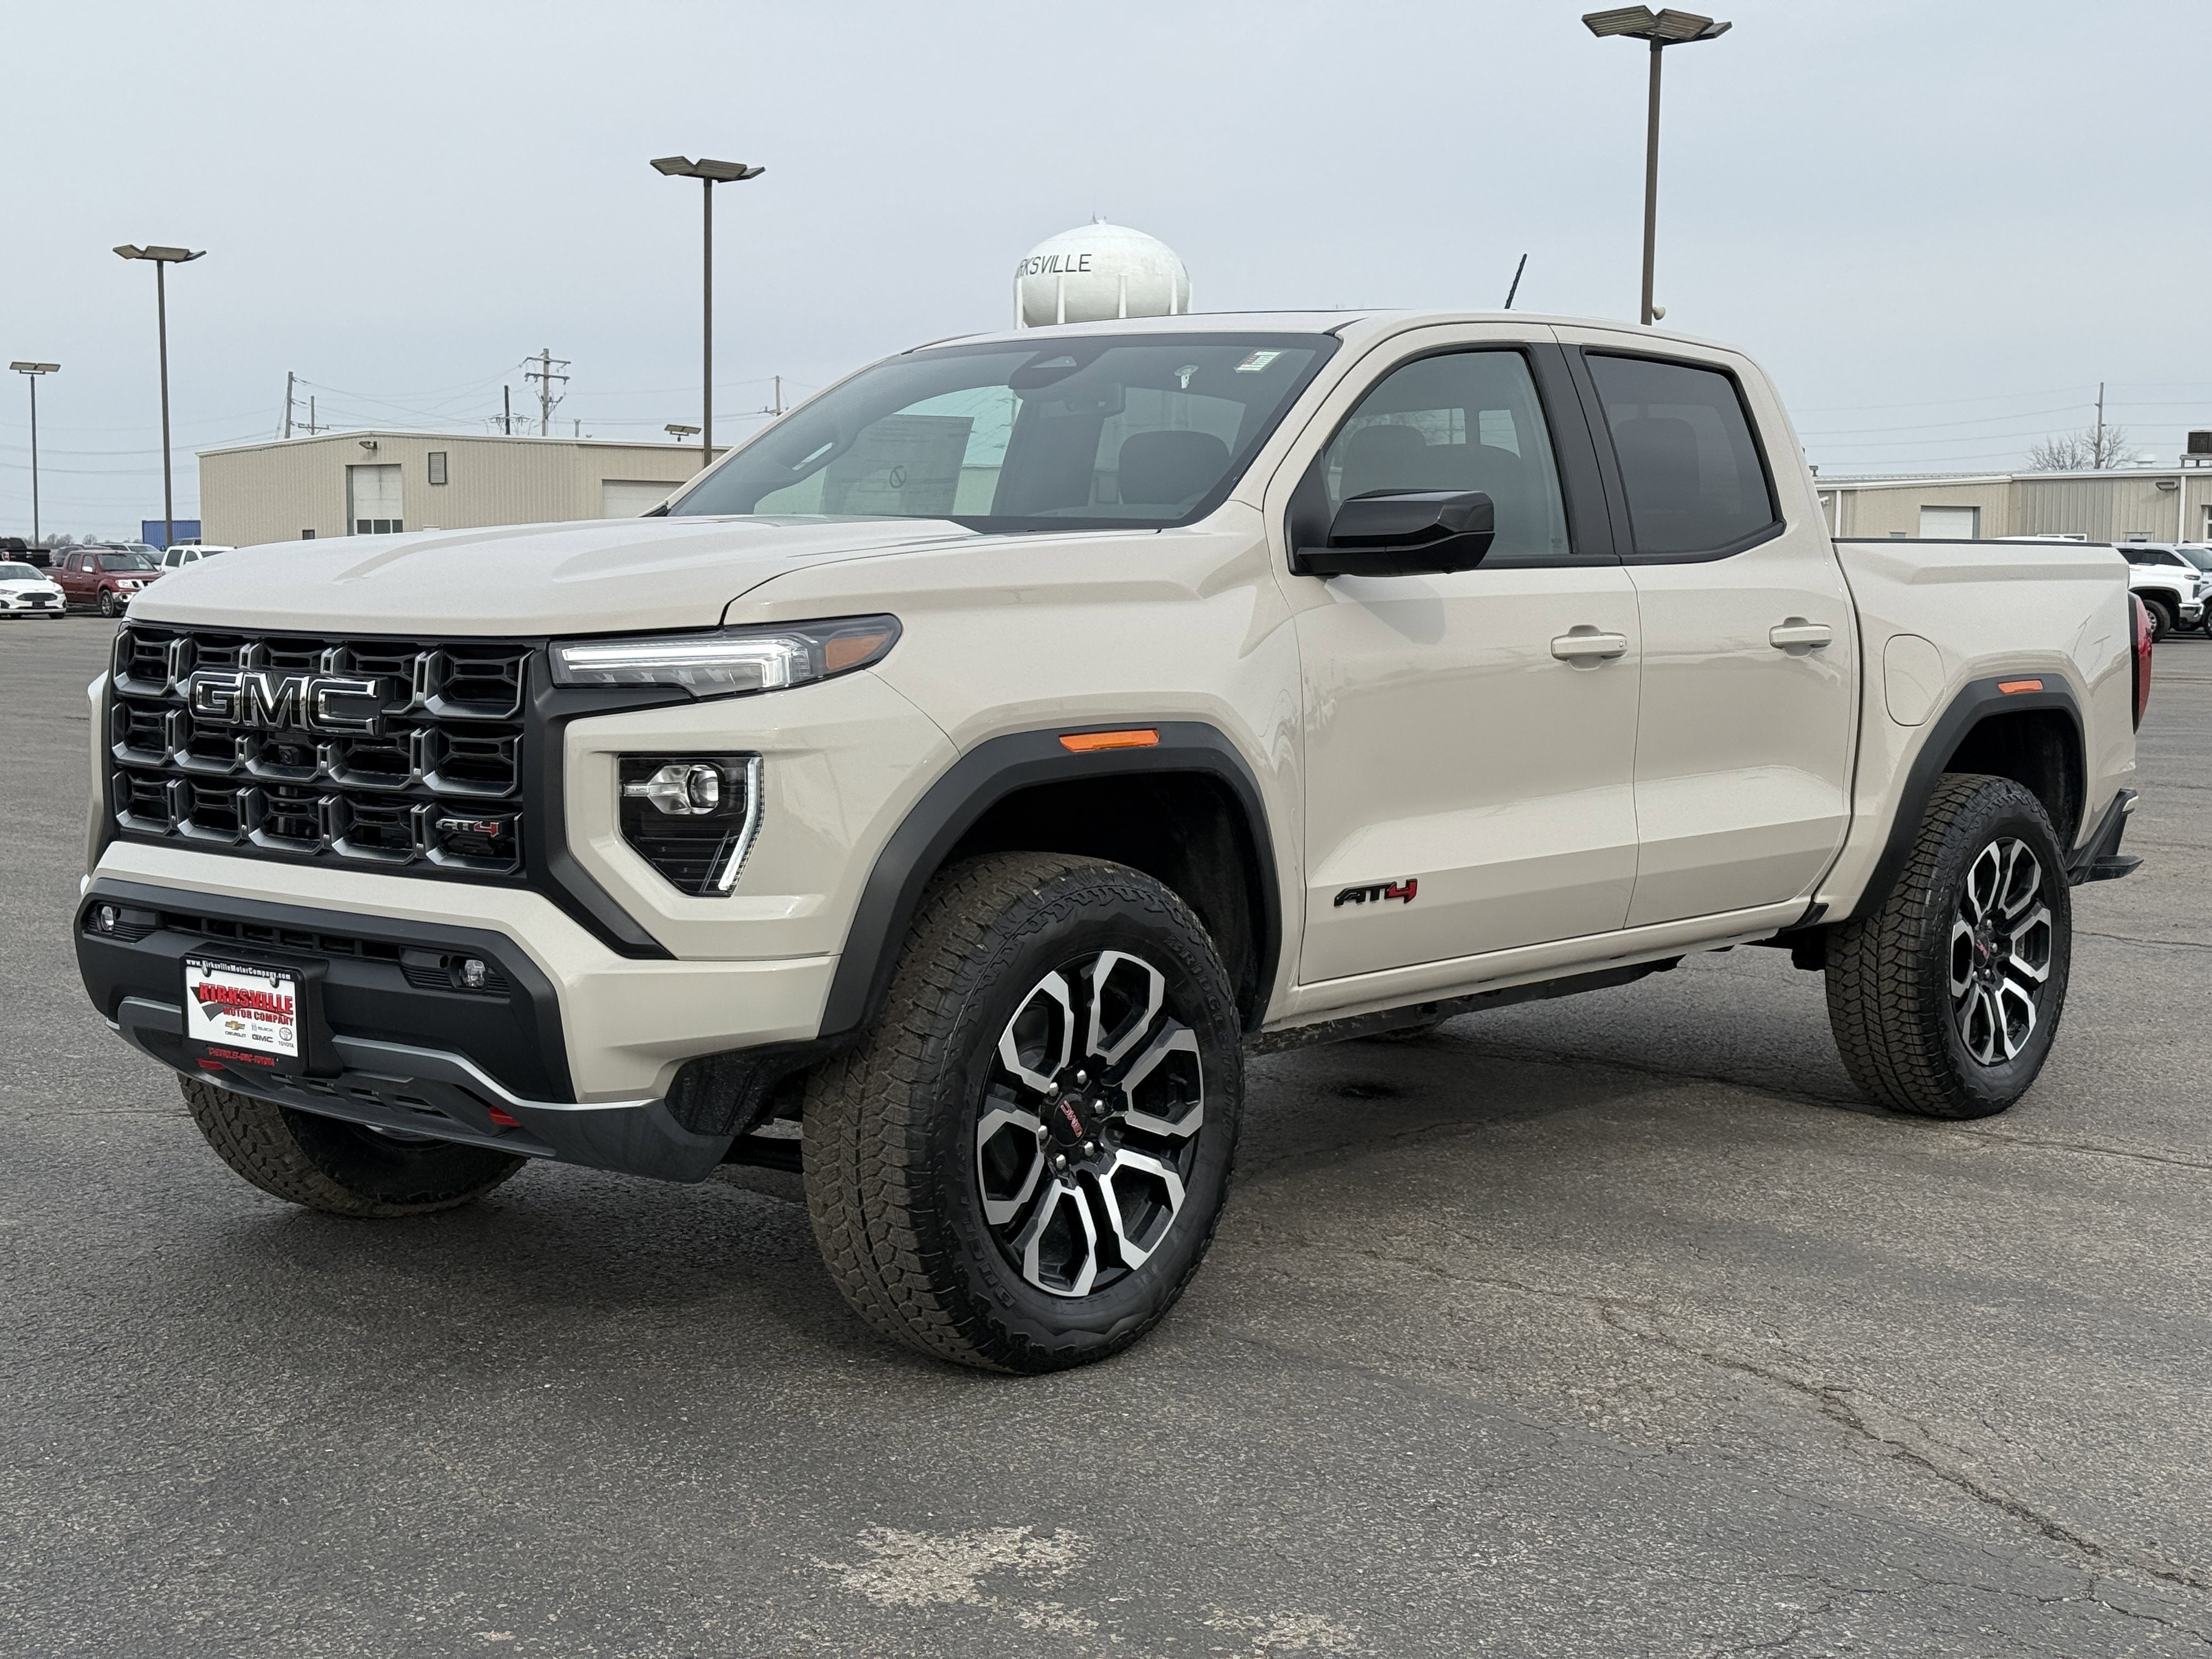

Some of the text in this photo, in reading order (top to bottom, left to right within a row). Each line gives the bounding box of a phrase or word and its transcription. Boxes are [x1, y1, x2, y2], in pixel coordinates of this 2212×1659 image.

[1015, 253, 1092, 279] RKSVILLE
[188, 670, 379, 736] GMC
[435, 817, 500, 839] AT4
[1334, 878, 1418, 907] AT4
[199, 981, 294, 1015] KIRKSVILLE
[223, 1006, 294, 1026] MOTOR COMPANY
[252, 1034, 274, 1043] GMC
[1163, 932, 1236, 1141] BRIDGESTONE
[1060, 1099, 1084, 1138] GMC
